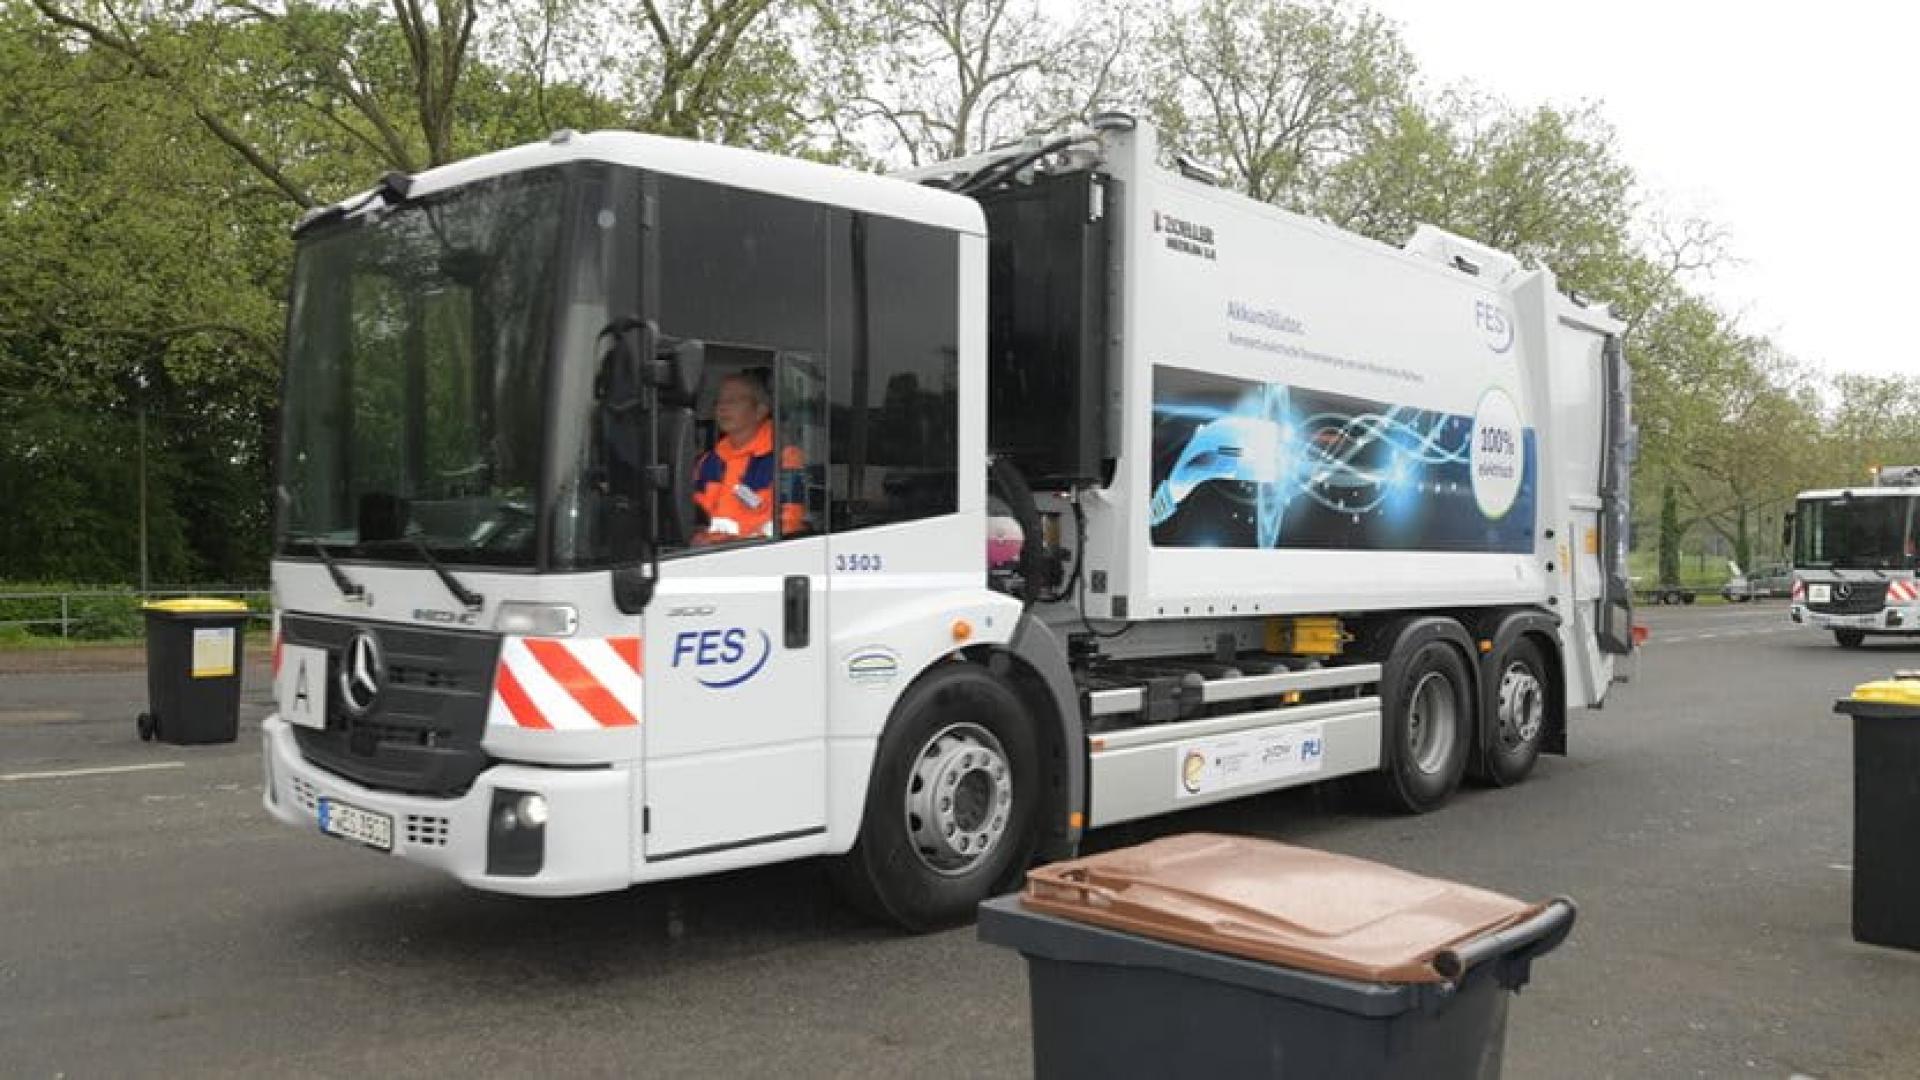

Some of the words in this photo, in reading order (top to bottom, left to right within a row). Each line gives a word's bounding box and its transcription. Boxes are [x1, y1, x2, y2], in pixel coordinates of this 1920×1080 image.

[1475, 300, 1505, 333] FES
[1481, 426, 1515, 456] 100%
[834, 553, 883, 572] 3503
[671, 626, 747, 668] FES
[292, 659, 311, 714] A
